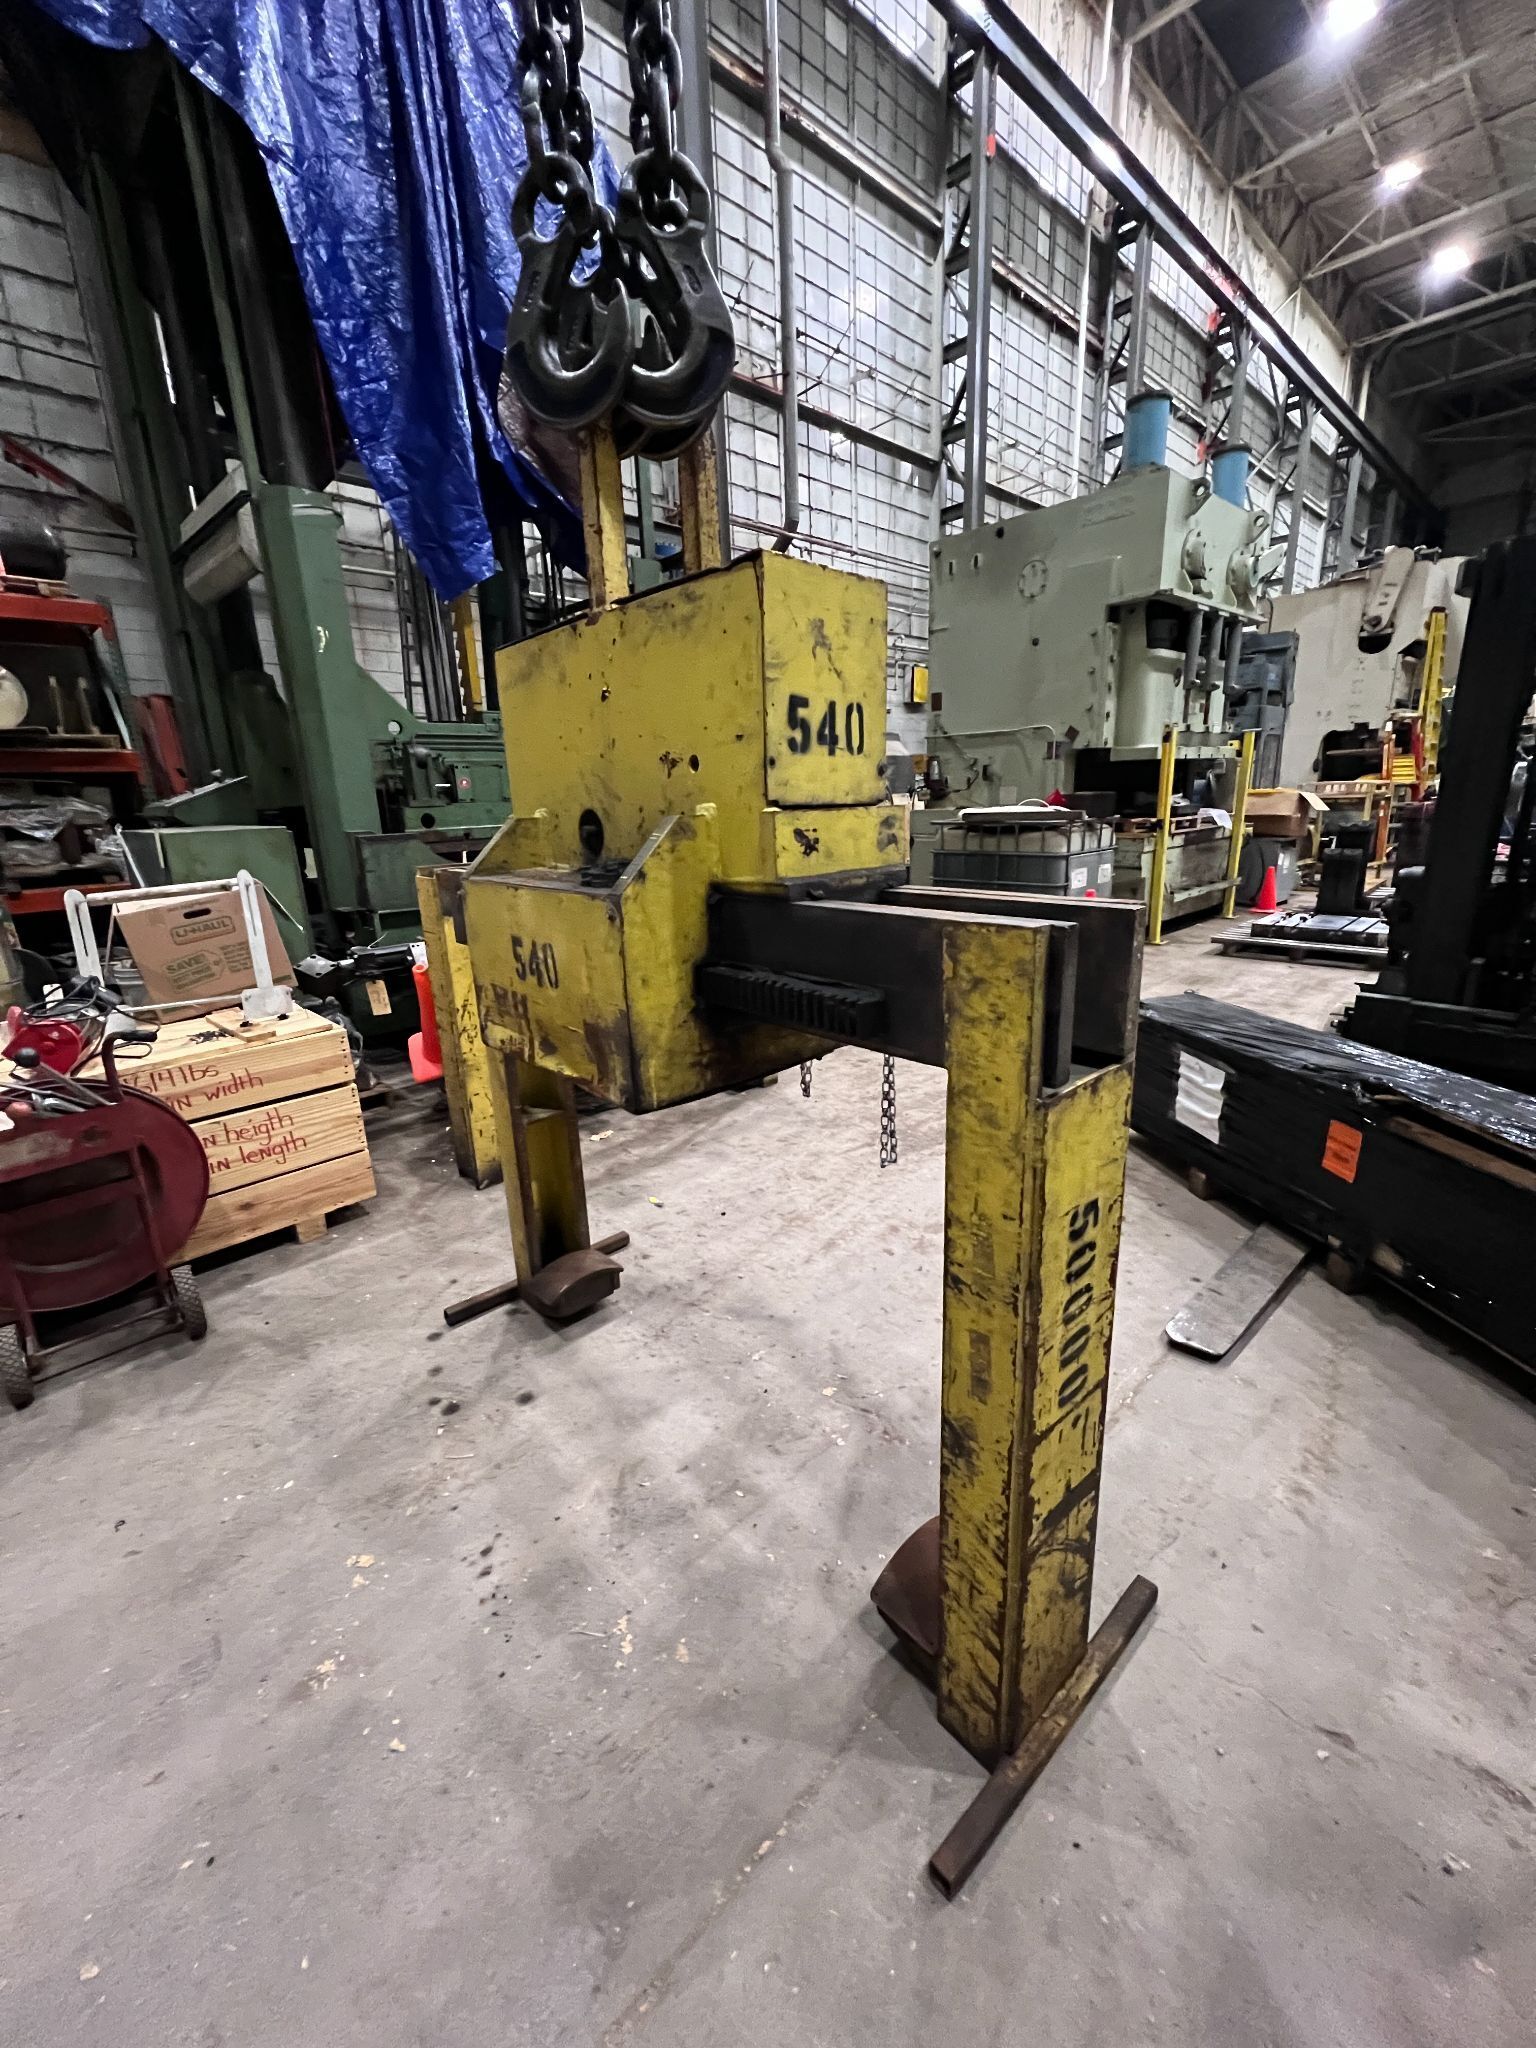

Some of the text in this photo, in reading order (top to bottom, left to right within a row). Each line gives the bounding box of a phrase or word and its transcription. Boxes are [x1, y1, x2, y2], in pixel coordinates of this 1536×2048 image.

[786, 693, 865, 757] 540
[510, 934, 560, 990] 540
[204, 1068, 264, 1101] width
[222, 1107, 295, 1146] heigth
[1057, 1197, 1100, 1410] 50000
